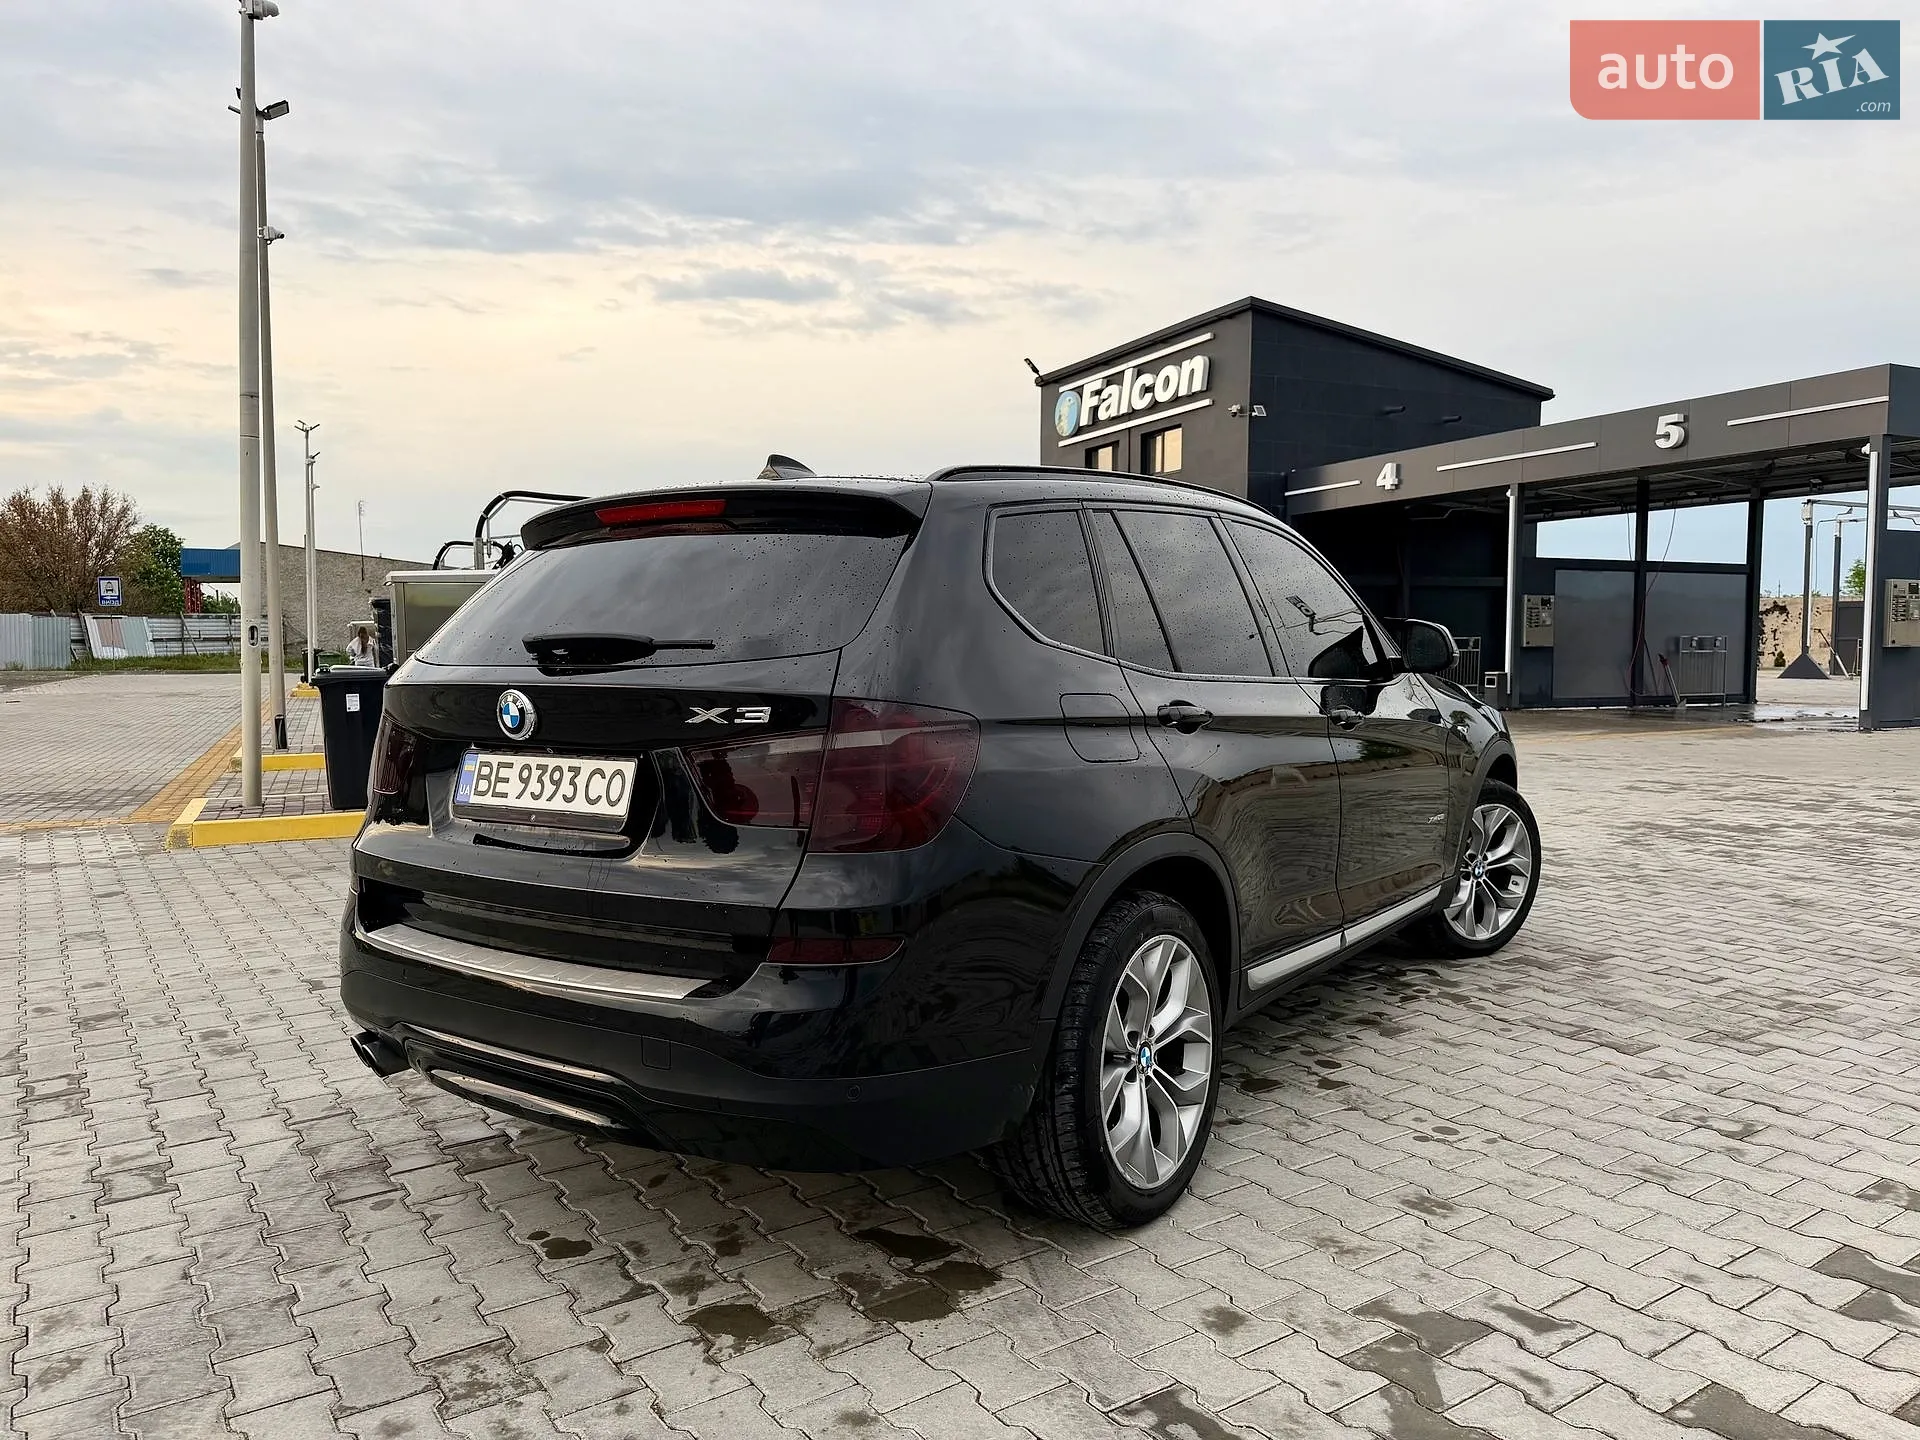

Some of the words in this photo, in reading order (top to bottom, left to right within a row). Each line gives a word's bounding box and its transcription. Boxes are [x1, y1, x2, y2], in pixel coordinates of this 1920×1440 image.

[1078, 354, 1211, 427] Falcon
[1655, 412, 1686, 449] 5
[1376, 461, 1401, 491] 4
[684, 706, 772, 725] X3
[459, 783, 471, 796] UA
[473, 760, 514, 799] BE
[515, 763, 582, 804] 9393
[584, 767, 626, 807] CO
